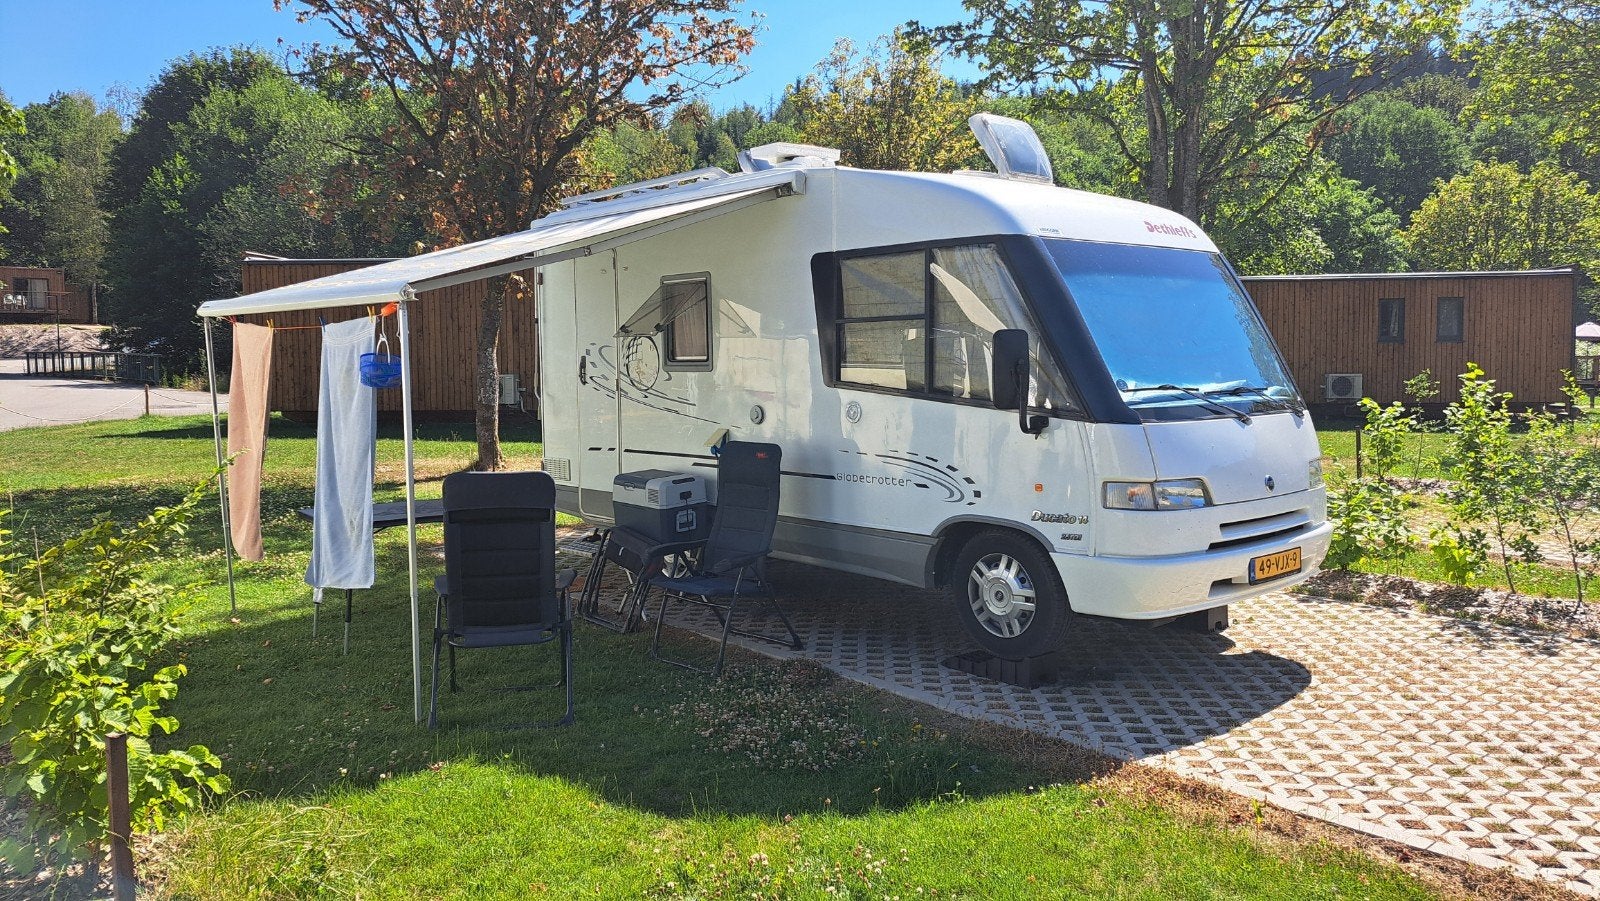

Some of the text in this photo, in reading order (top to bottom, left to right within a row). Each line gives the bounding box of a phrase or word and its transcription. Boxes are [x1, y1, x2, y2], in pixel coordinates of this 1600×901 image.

[836, 472, 912, 487] Globetrotter
[1031, 509, 1077, 525] Ducato
[1259, 552, 1298, 576] 49-VJX-9
